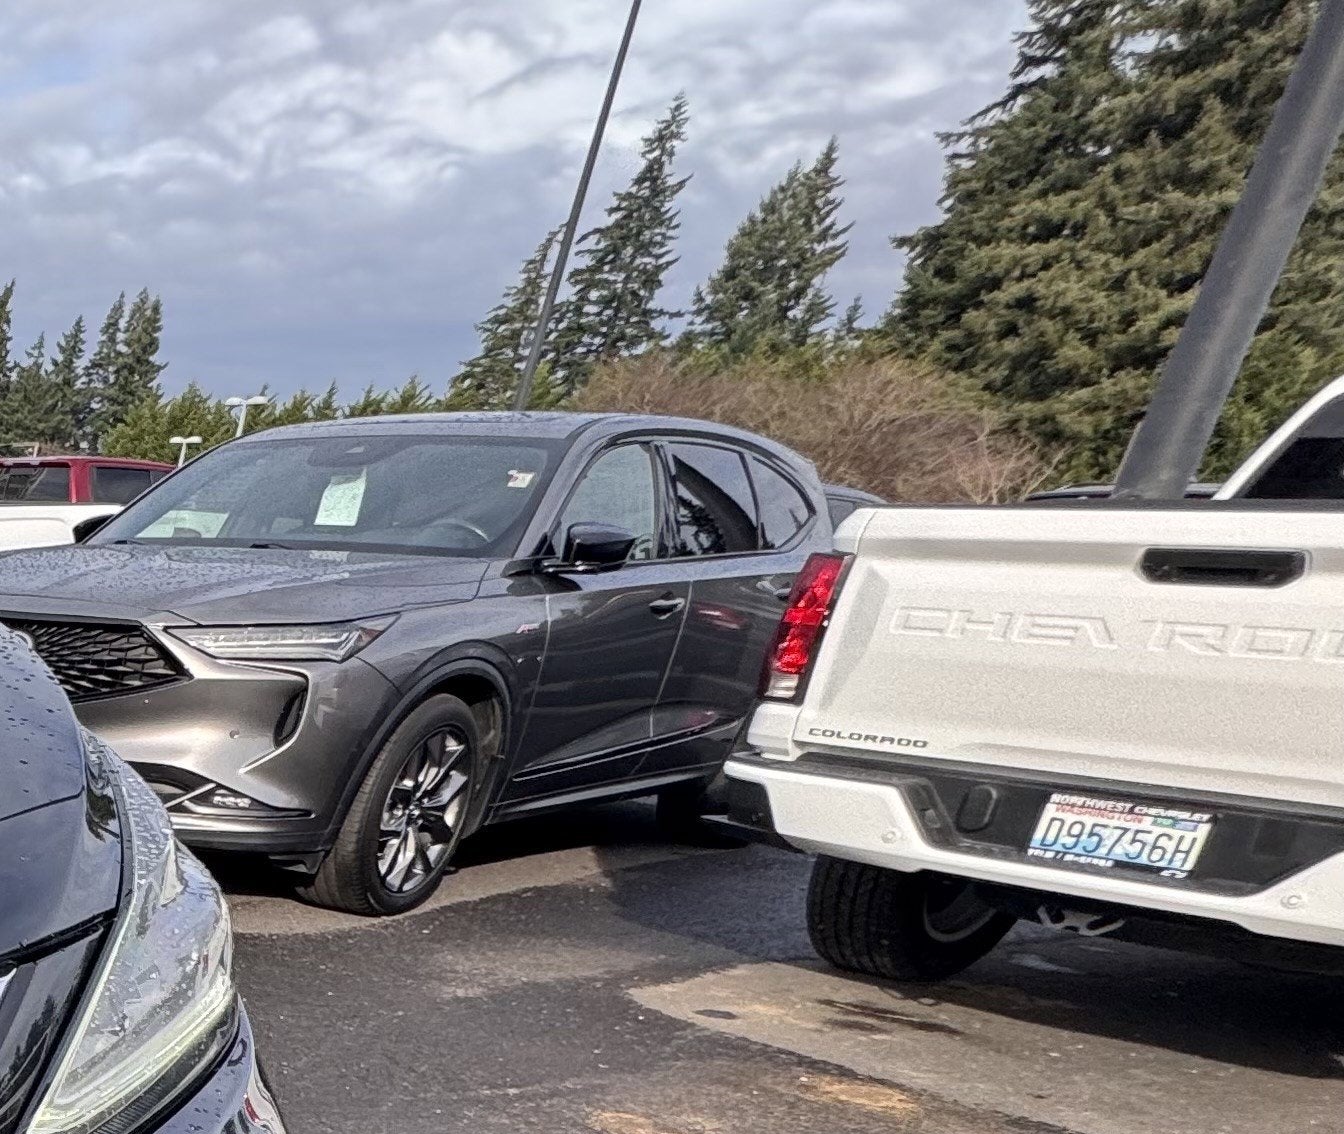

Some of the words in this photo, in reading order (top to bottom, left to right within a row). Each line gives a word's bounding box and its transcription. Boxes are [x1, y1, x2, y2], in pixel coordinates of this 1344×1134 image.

[808, 727, 929, 748] COLORADO
[1049, 793, 1133, 814] NORTHWEST
[1055, 804, 1145, 824] WASHINGTON
[1039, 816, 1198, 868] D95756H
